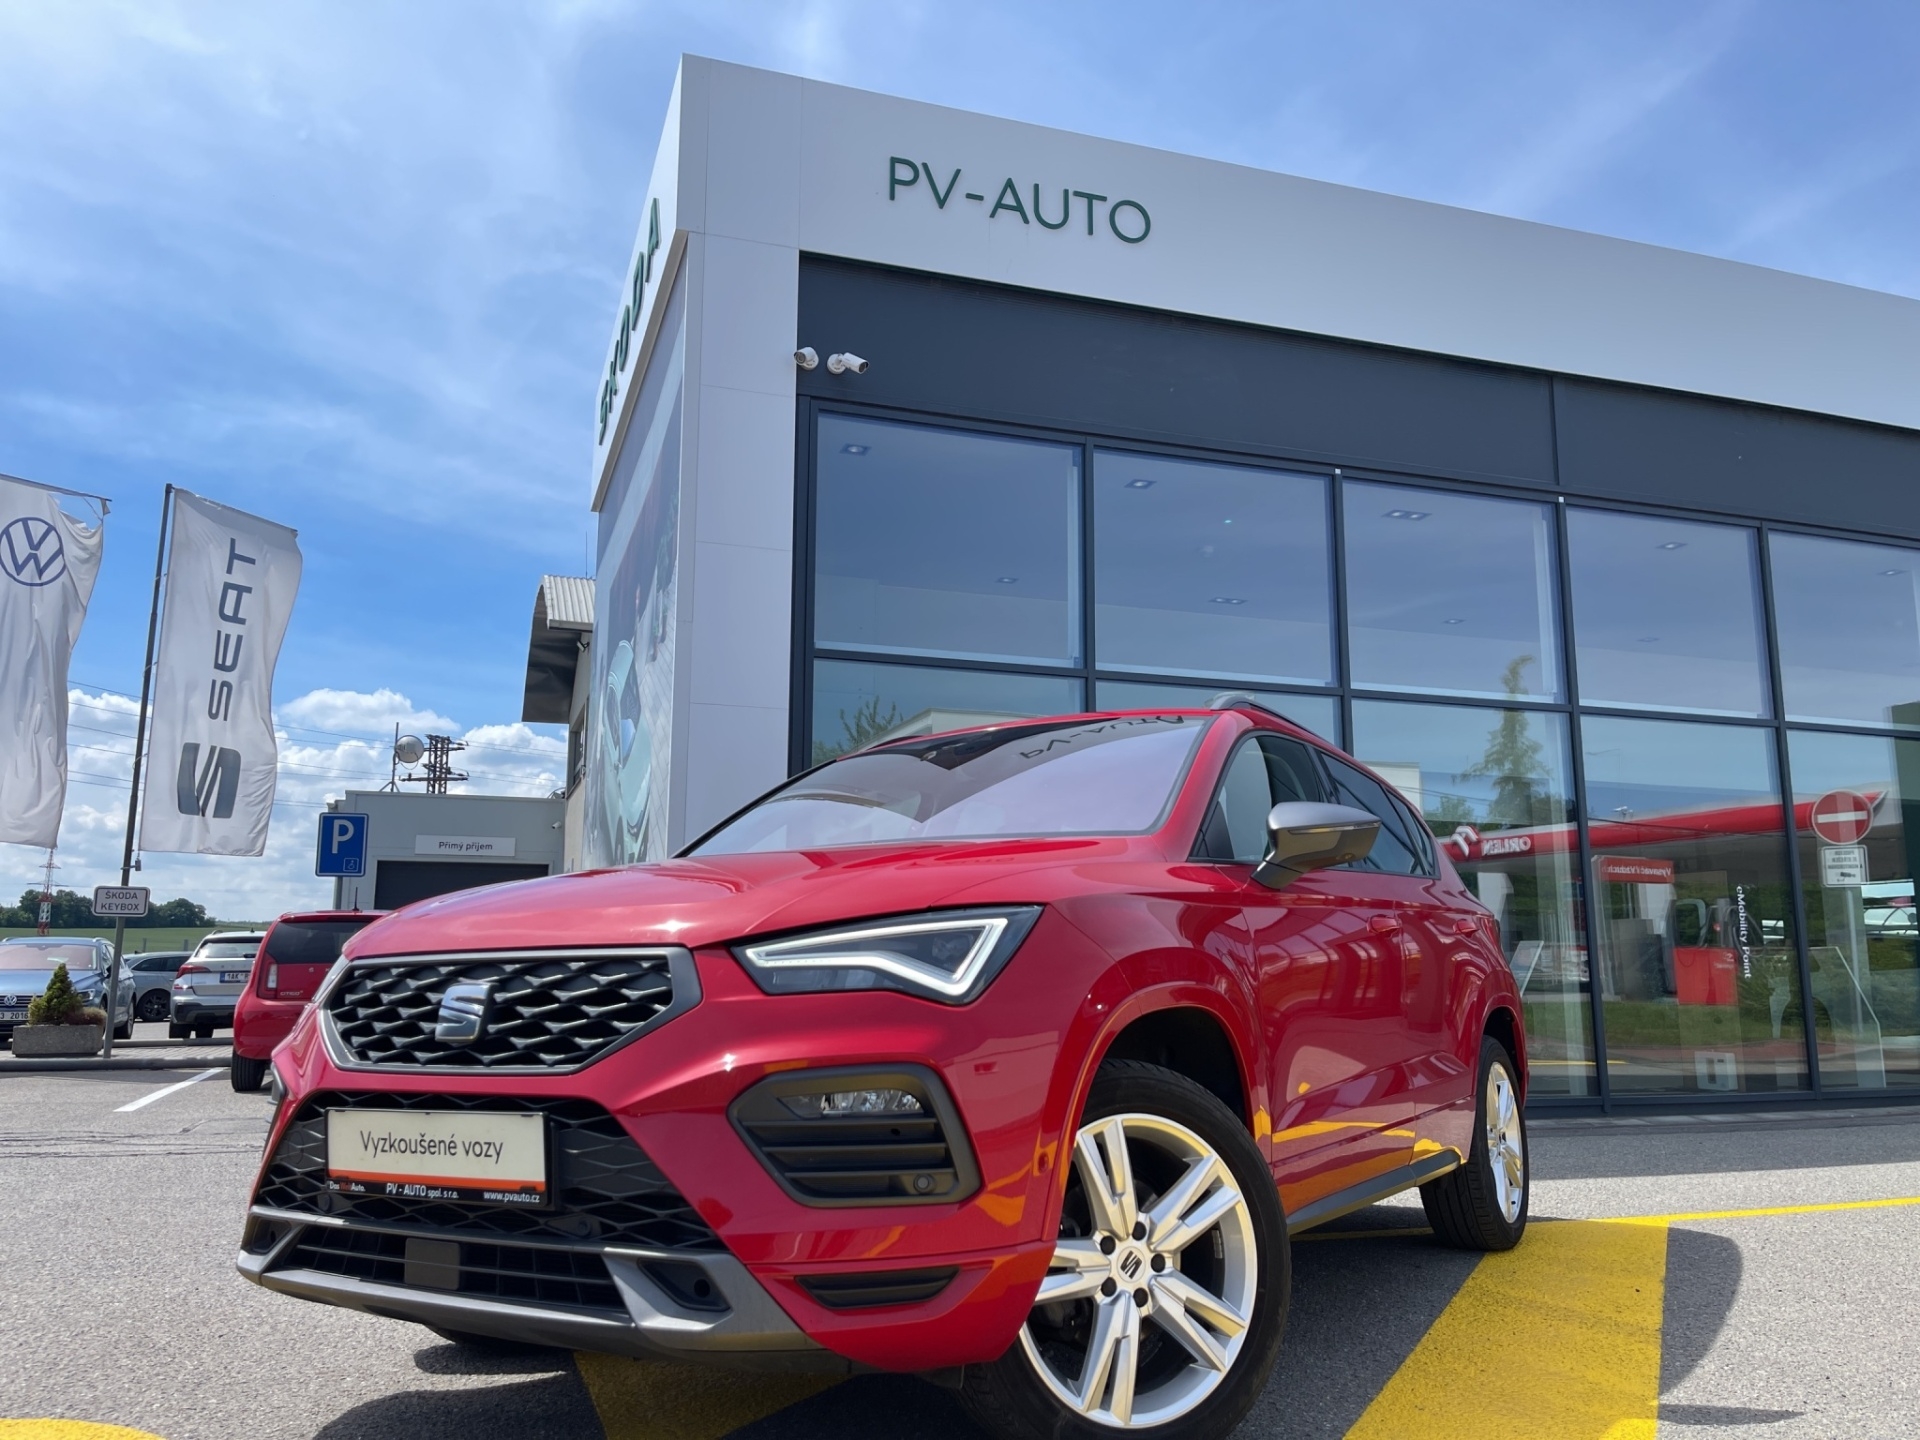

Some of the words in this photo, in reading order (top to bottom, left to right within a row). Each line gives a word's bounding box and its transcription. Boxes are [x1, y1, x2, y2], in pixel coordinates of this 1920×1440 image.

[889, 156, 1151, 243] PV-AUTO
[207, 537, 256, 722] SEAT
[331, 819, 354, 854] P
[101, 902, 139, 911] KEYBOX
[105, 890, 138, 900] ŠKODA
[1736, 885, 1748, 943] eMobility
[1742, 946, 1752, 979] Point
[360, 1130, 457, 1158] Vyzkoušené
[462, 1140, 503, 1164] vozy
[386, 1182, 398, 1194] PV
[403, 1184, 426, 1196] AUTO
[483, 1191, 540, 1203] www.pvauto.cz
